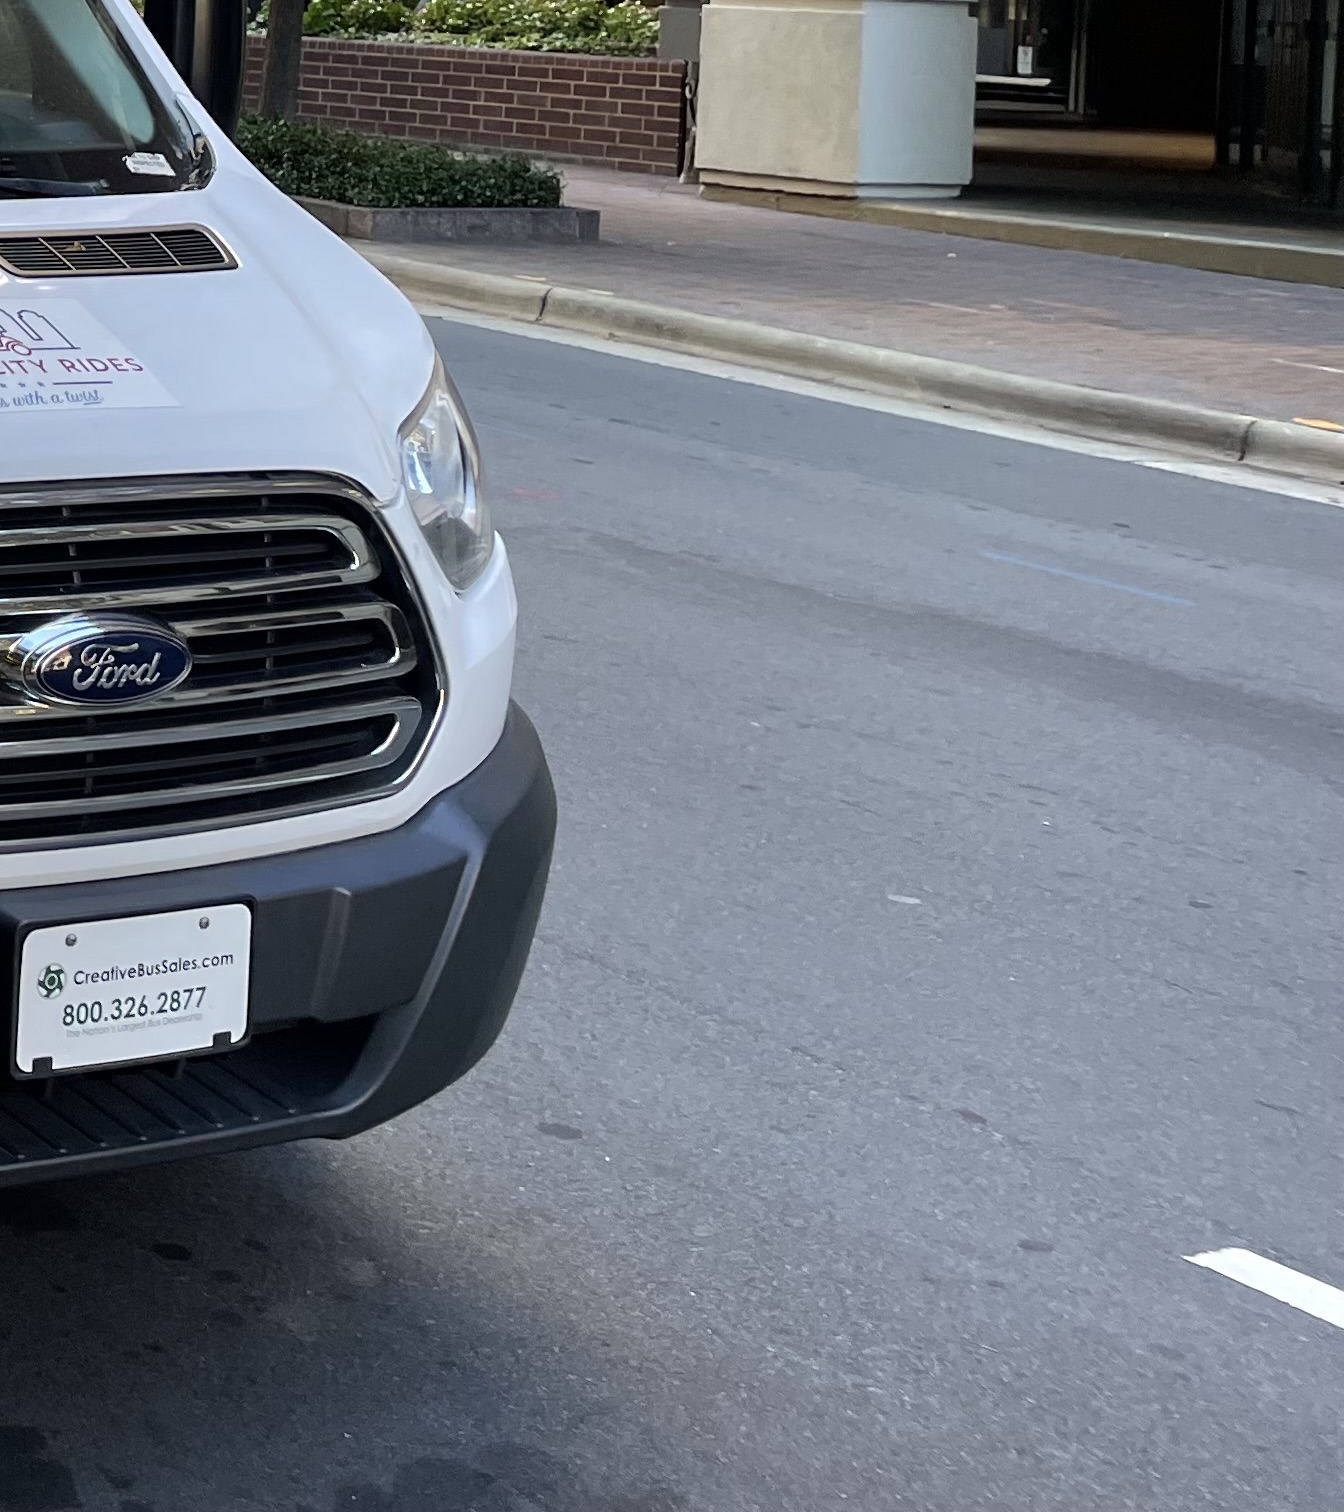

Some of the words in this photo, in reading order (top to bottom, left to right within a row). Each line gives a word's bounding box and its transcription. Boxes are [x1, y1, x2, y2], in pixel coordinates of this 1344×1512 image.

[58, 357, 144, 373] RIDES
[12, 390, 48, 407] with
[50, 393, 64, 404] a
[64, 389, 104, 405] twist
[72, 642, 163, 691] Ford
[73, 953, 234, 985] CreativeBusSales.com
[62, 986, 208, 1027] 800.326.2877
